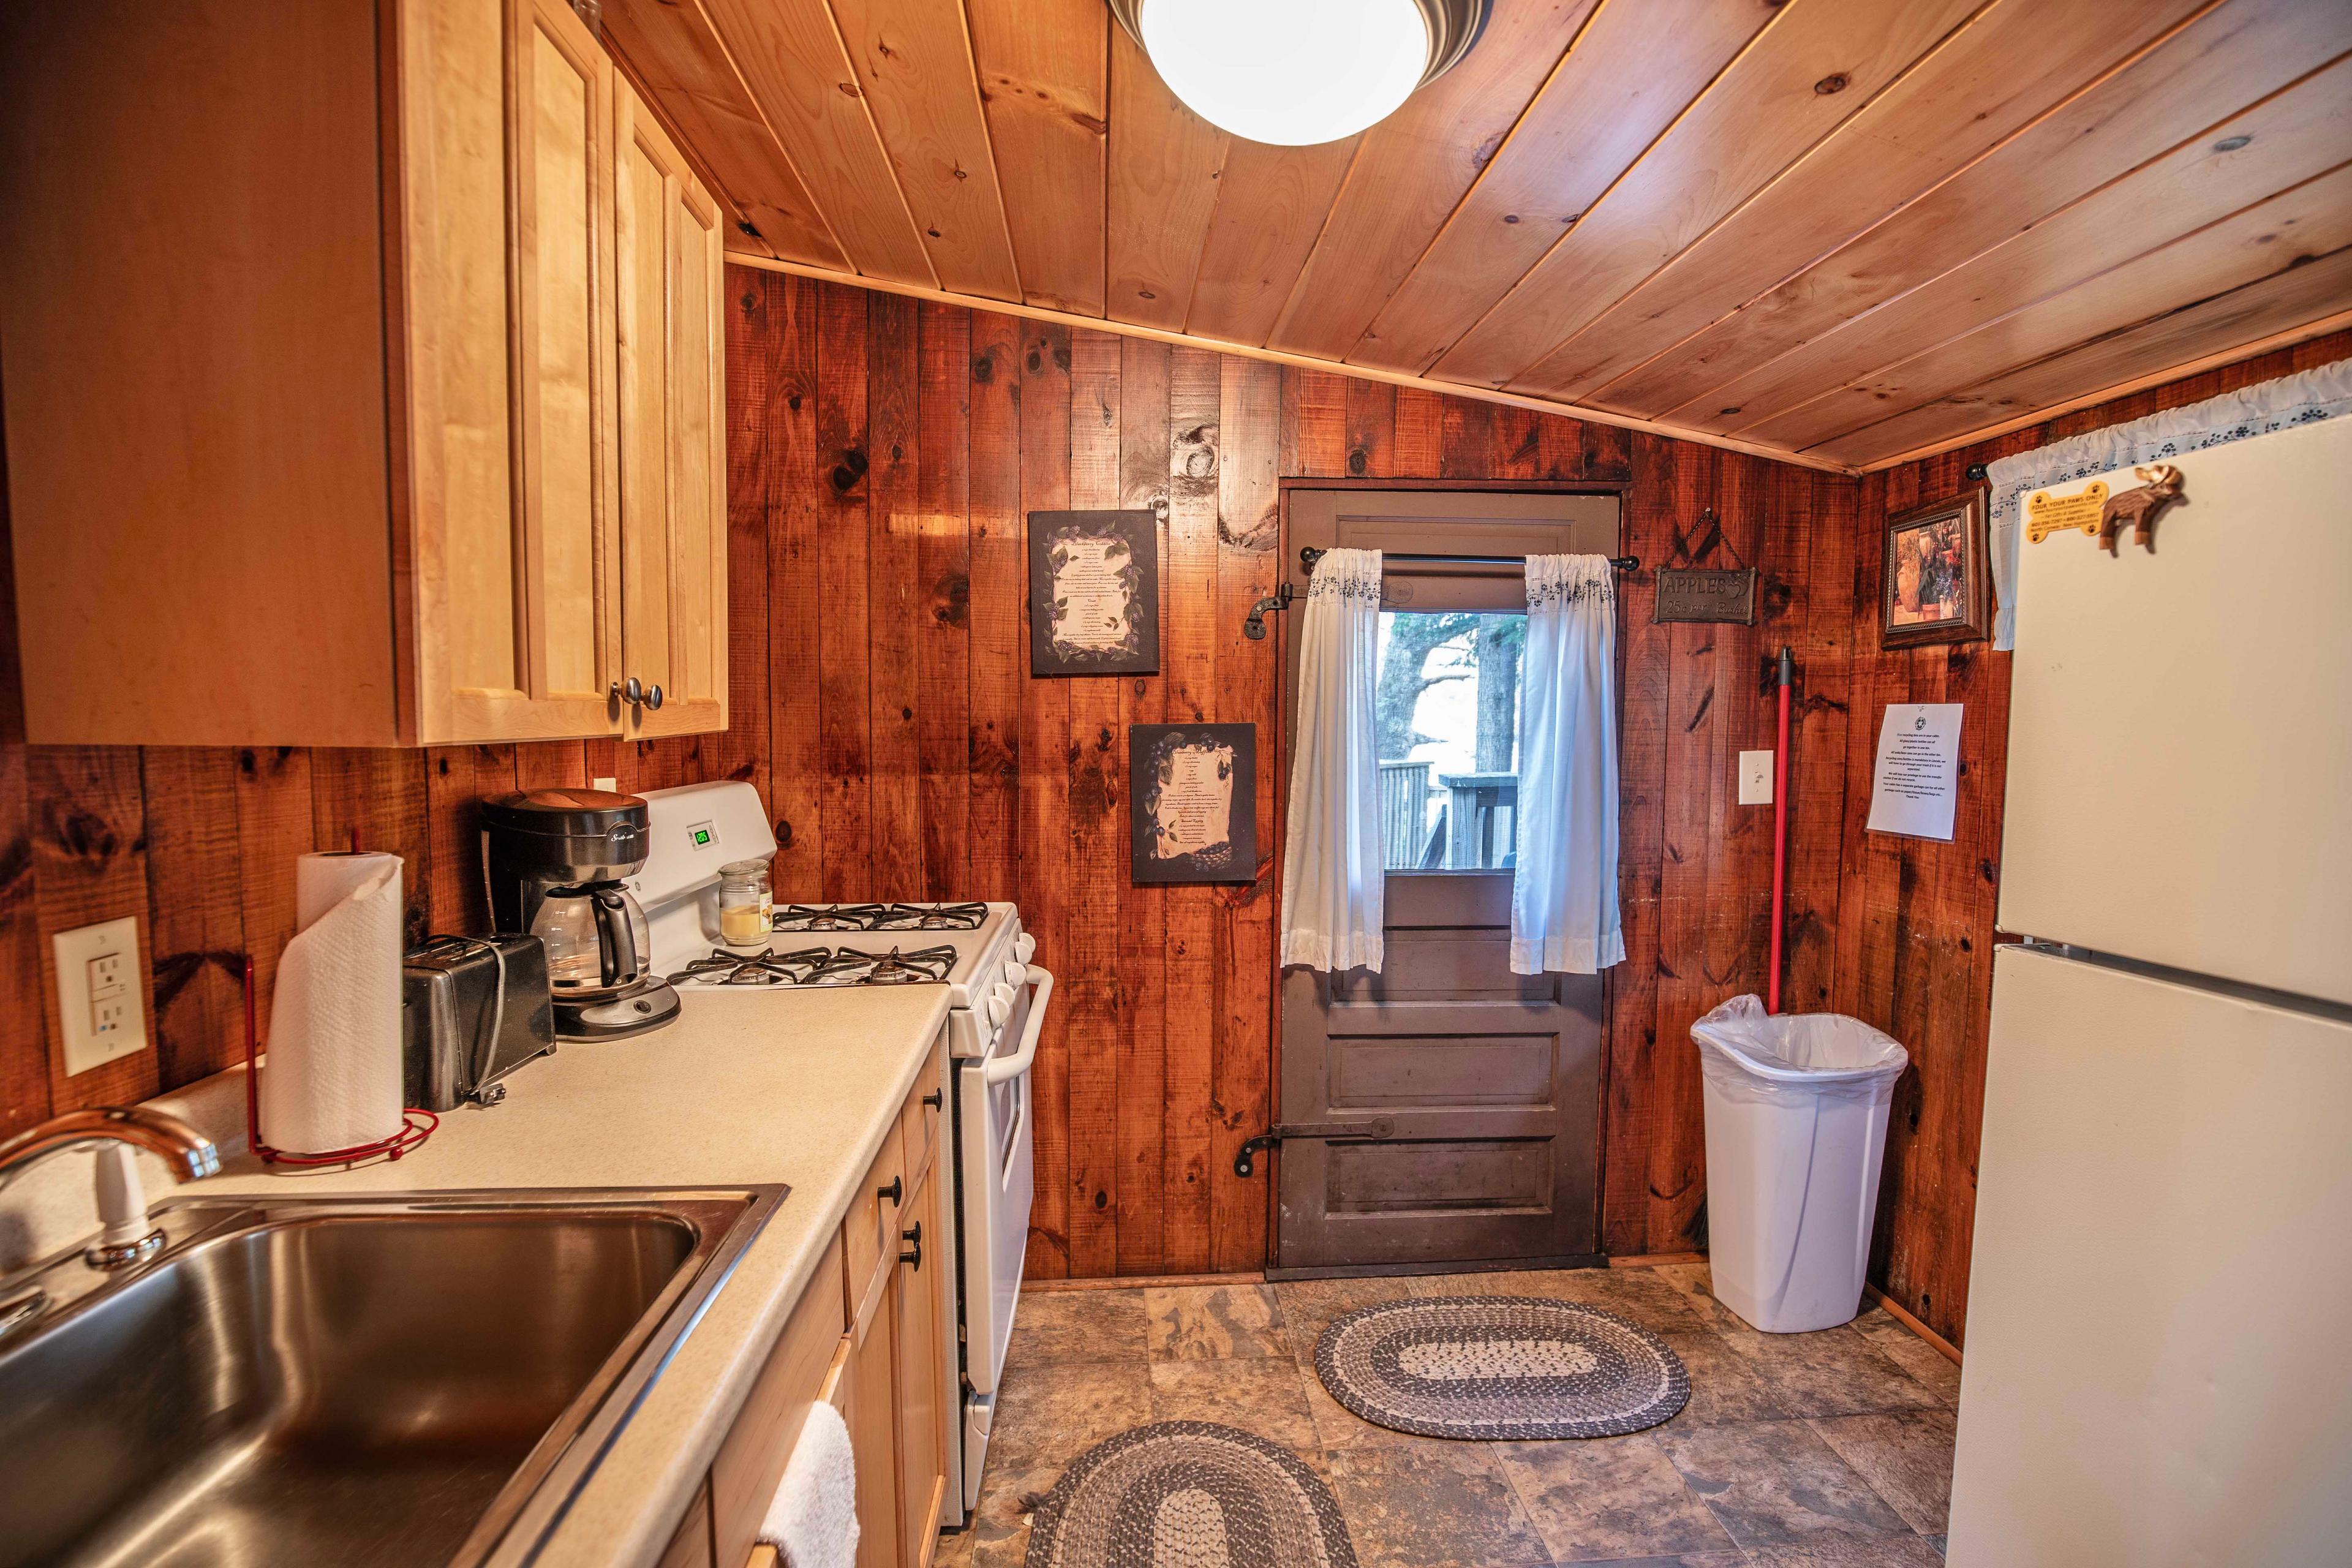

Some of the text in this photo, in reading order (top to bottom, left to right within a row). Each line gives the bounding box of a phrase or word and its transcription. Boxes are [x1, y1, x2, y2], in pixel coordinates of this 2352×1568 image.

[1664, 577, 1726, 594] APPLES
[1689, 604, 1707, 614] per
[1717, 602, 1749, 614] Bushel
